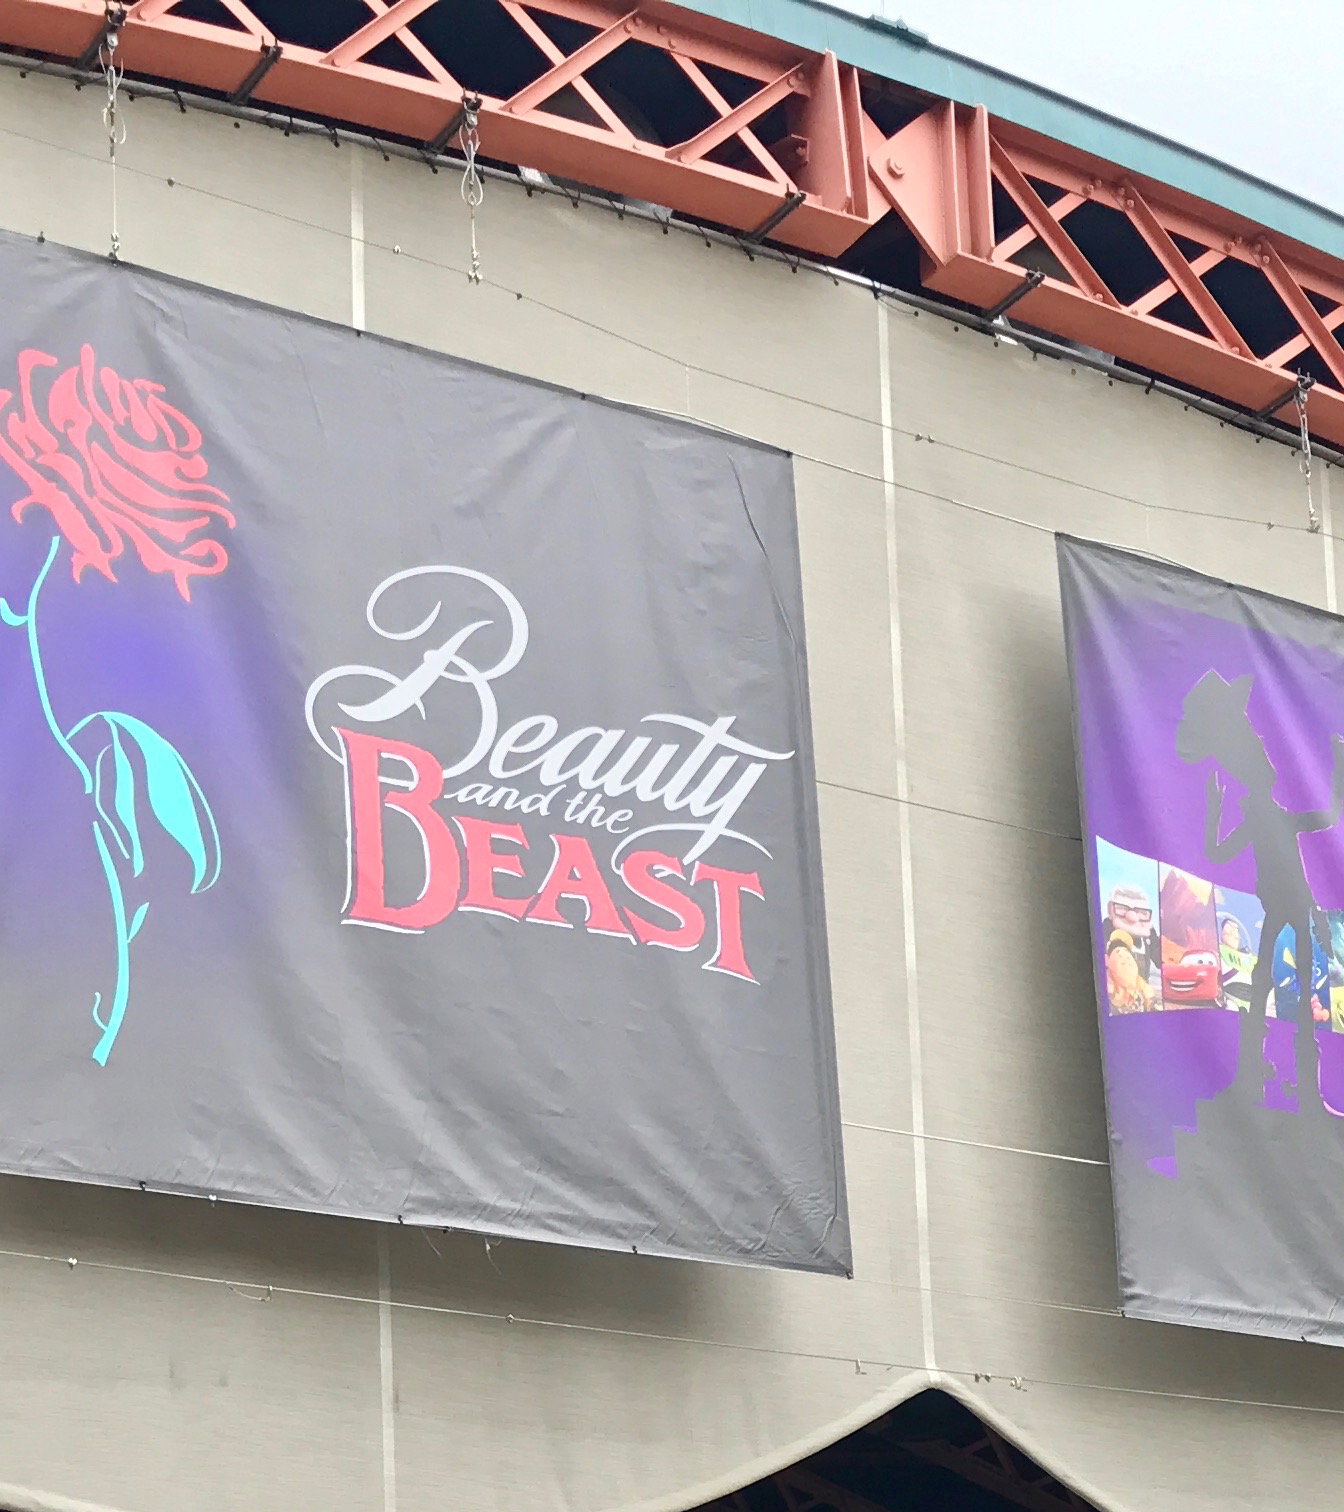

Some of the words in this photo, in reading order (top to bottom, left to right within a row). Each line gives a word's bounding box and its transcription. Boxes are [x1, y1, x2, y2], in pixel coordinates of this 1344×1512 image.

[305, 565, 795, 864] Beauty
[444, 780, 563, 816] and
[563, 793, 633, 834] the
[331, 725, 766, 985] BEAST
